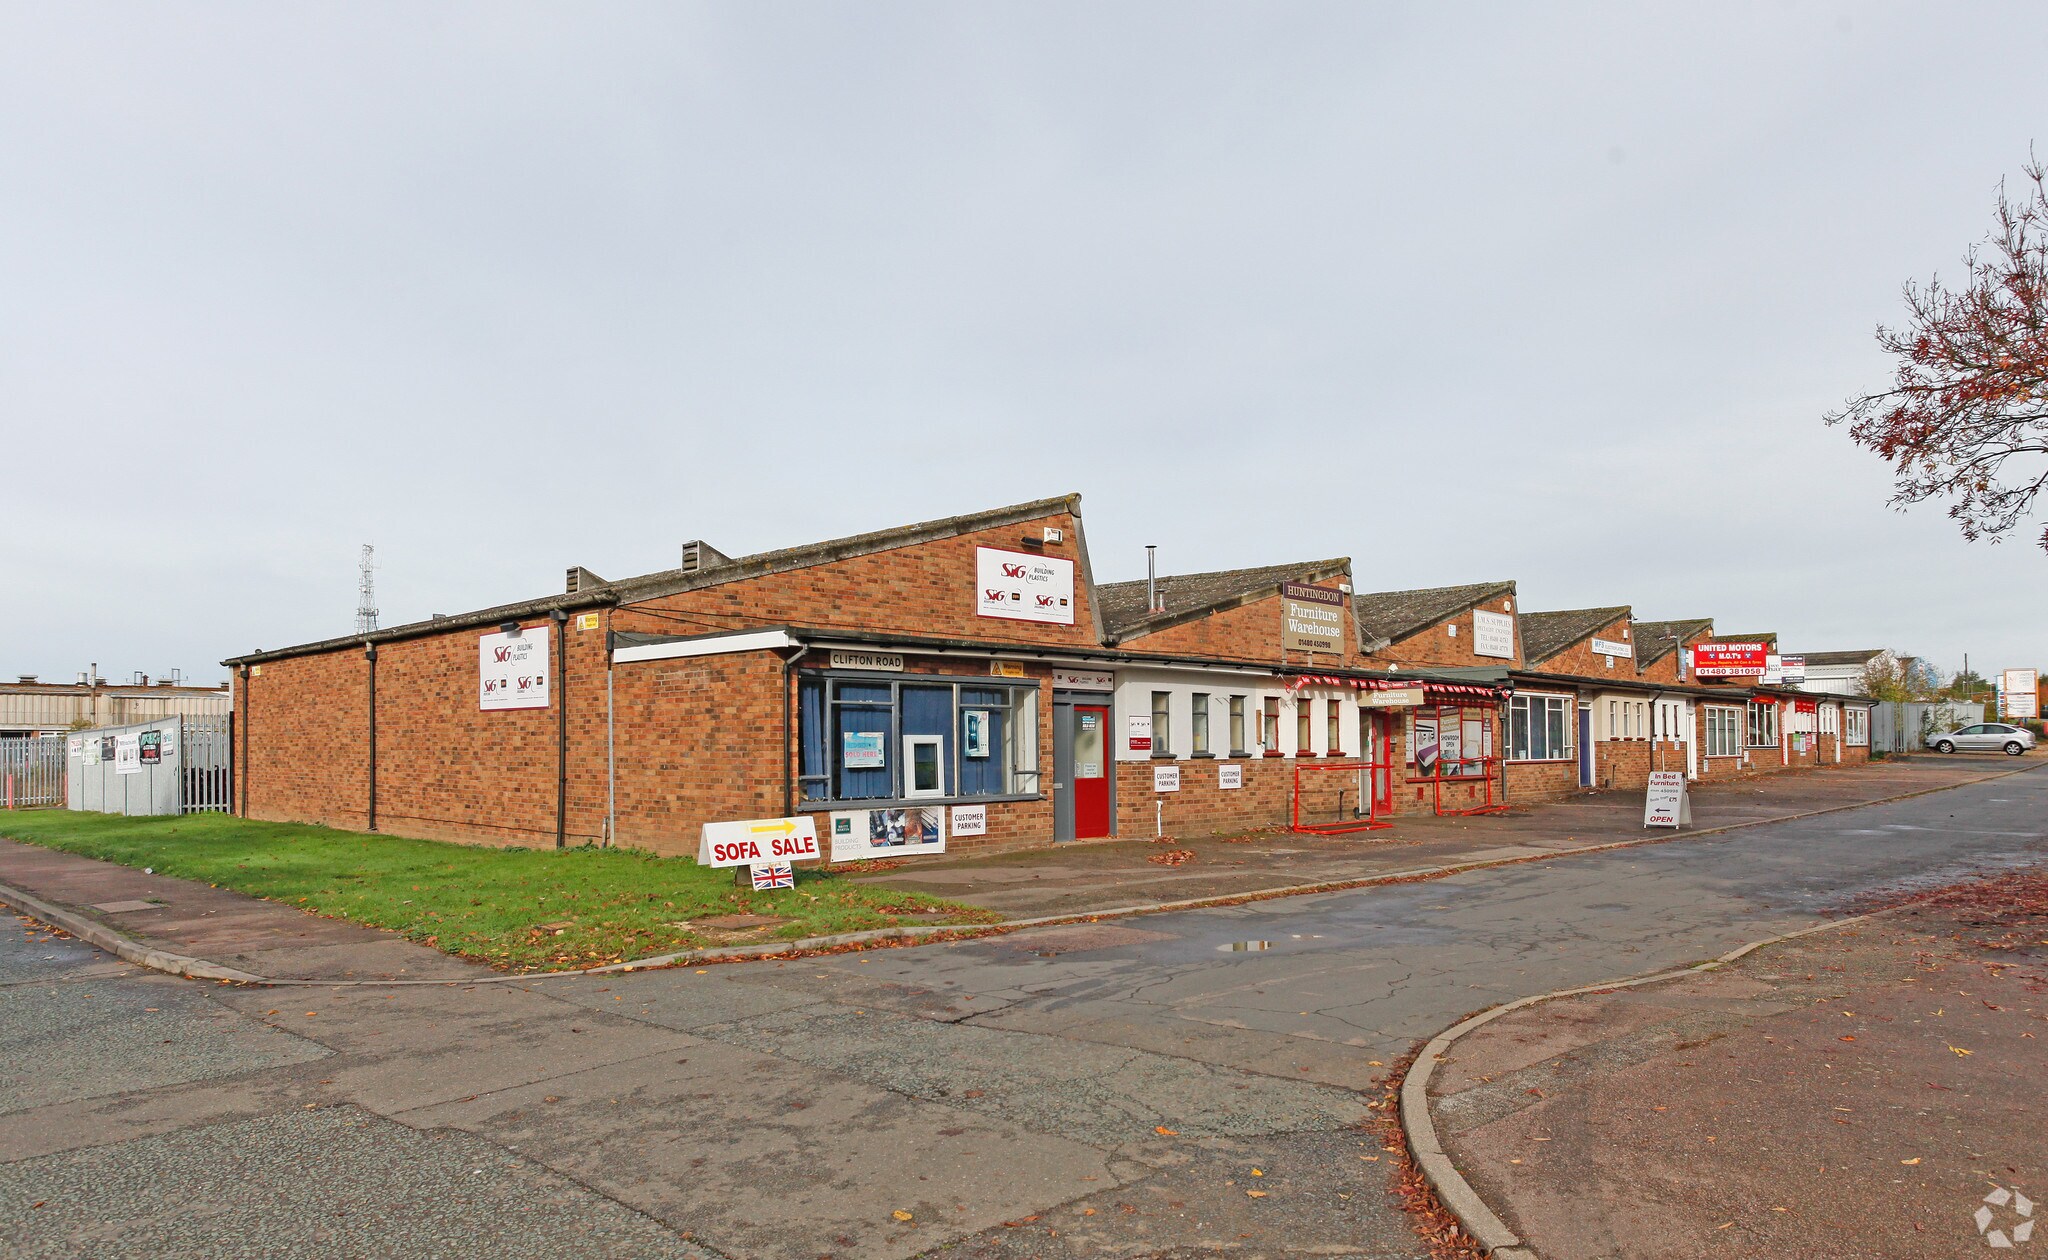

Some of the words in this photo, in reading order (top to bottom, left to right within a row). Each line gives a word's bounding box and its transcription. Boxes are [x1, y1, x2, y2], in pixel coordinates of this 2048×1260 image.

[1029, 574, 1048, 582] PLASTICS
[1287, 585, 1339, 602] HUNTINGDON
[1290, 603, 1338, 622] Furniture
[1288, 618, 1340, 637] Warehouse
[517, 643, 533, 651] BUILDING
[1298, 639, 1312, 647] 01480
[1314, 640, 1331, 648] 450998
[513, 653, 527, 661] PLASTICS
[833, 654, 873, 666] CLIFTON
[876, 656, 901, 667] ROAD
[954, 812, 984, 822] CUSTOMER
[957, 820, 982, 831] PARKING
[714, 841, 761, 863] SOFA
[771, 836, 815, 857] SALE
